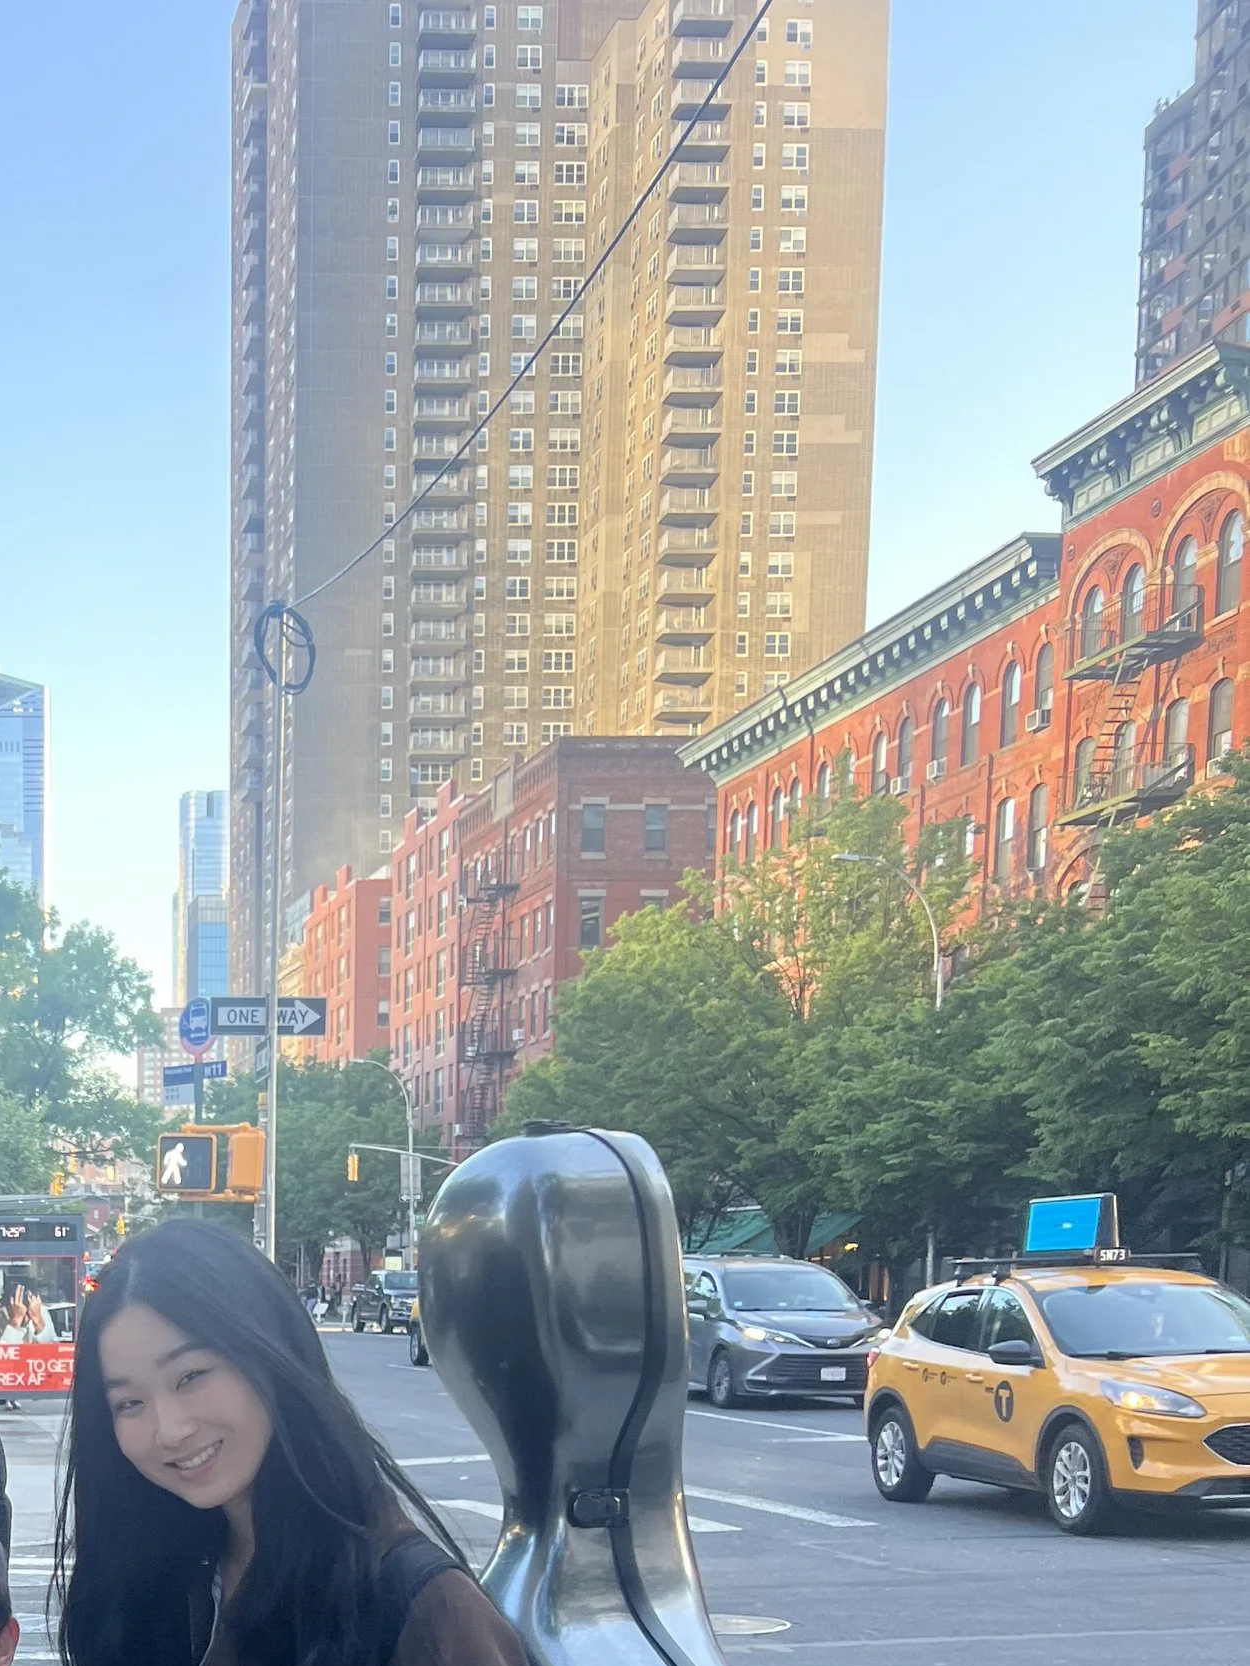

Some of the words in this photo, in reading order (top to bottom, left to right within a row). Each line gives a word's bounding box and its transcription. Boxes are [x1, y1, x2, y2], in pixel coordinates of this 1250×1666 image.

[227, 1009, 259, 1024] ONE
[277, 1009, 309, 1024] WAY
[1100, 1248, 1126, 1261] 5N73
[26, 1359, 46, 1373] TO
[47, 1359, 75, 1373] GET
[27, 1372, 46, 1385] AF
